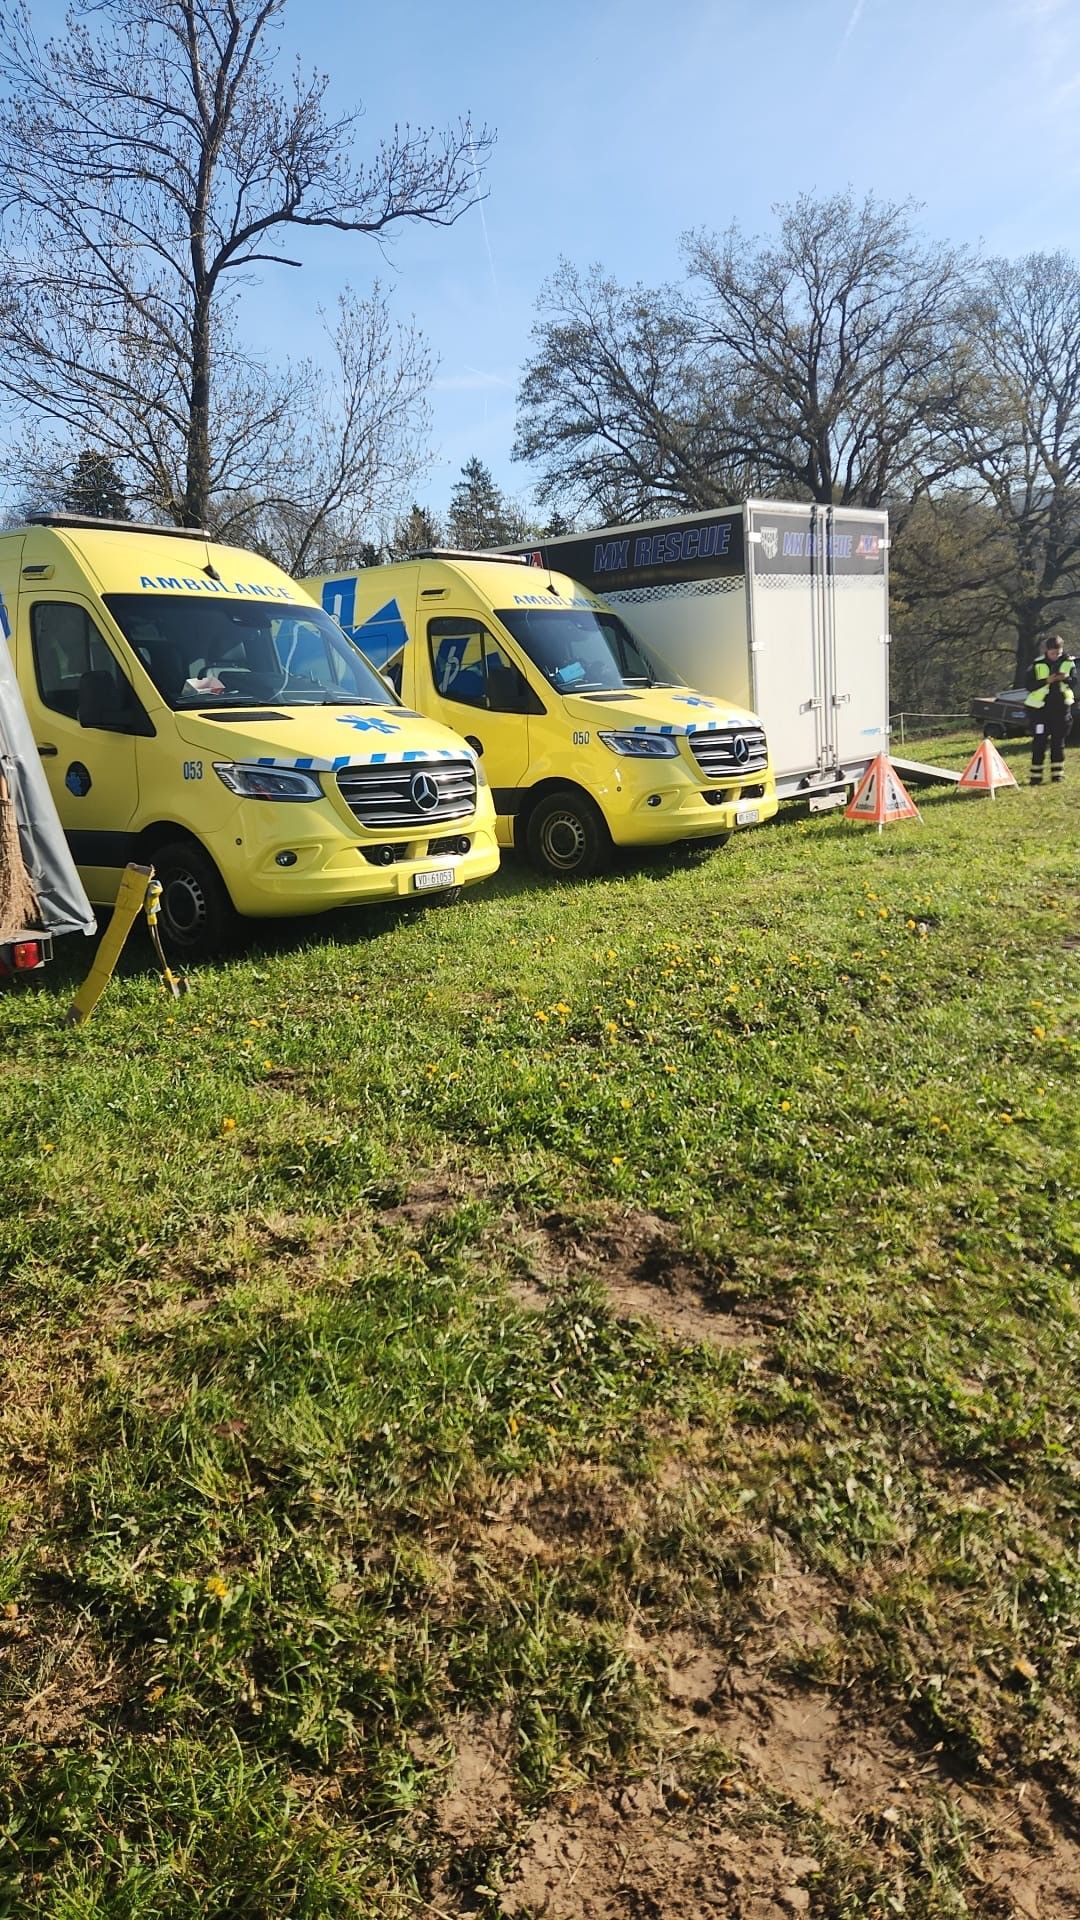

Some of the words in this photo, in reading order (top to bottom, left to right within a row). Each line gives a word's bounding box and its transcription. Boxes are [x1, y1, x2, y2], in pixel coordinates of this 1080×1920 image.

[593, 539, 630, 573] MX
[634, 523, 732, 567] RESCUE
[782, 531, 805, 557] MX
[139, 576, 295, 600] AMBULANCE
[573, 731, 590, 745] 050
[183, 760, 203, 780] 053
[431, 870, 453, 885] 61053
